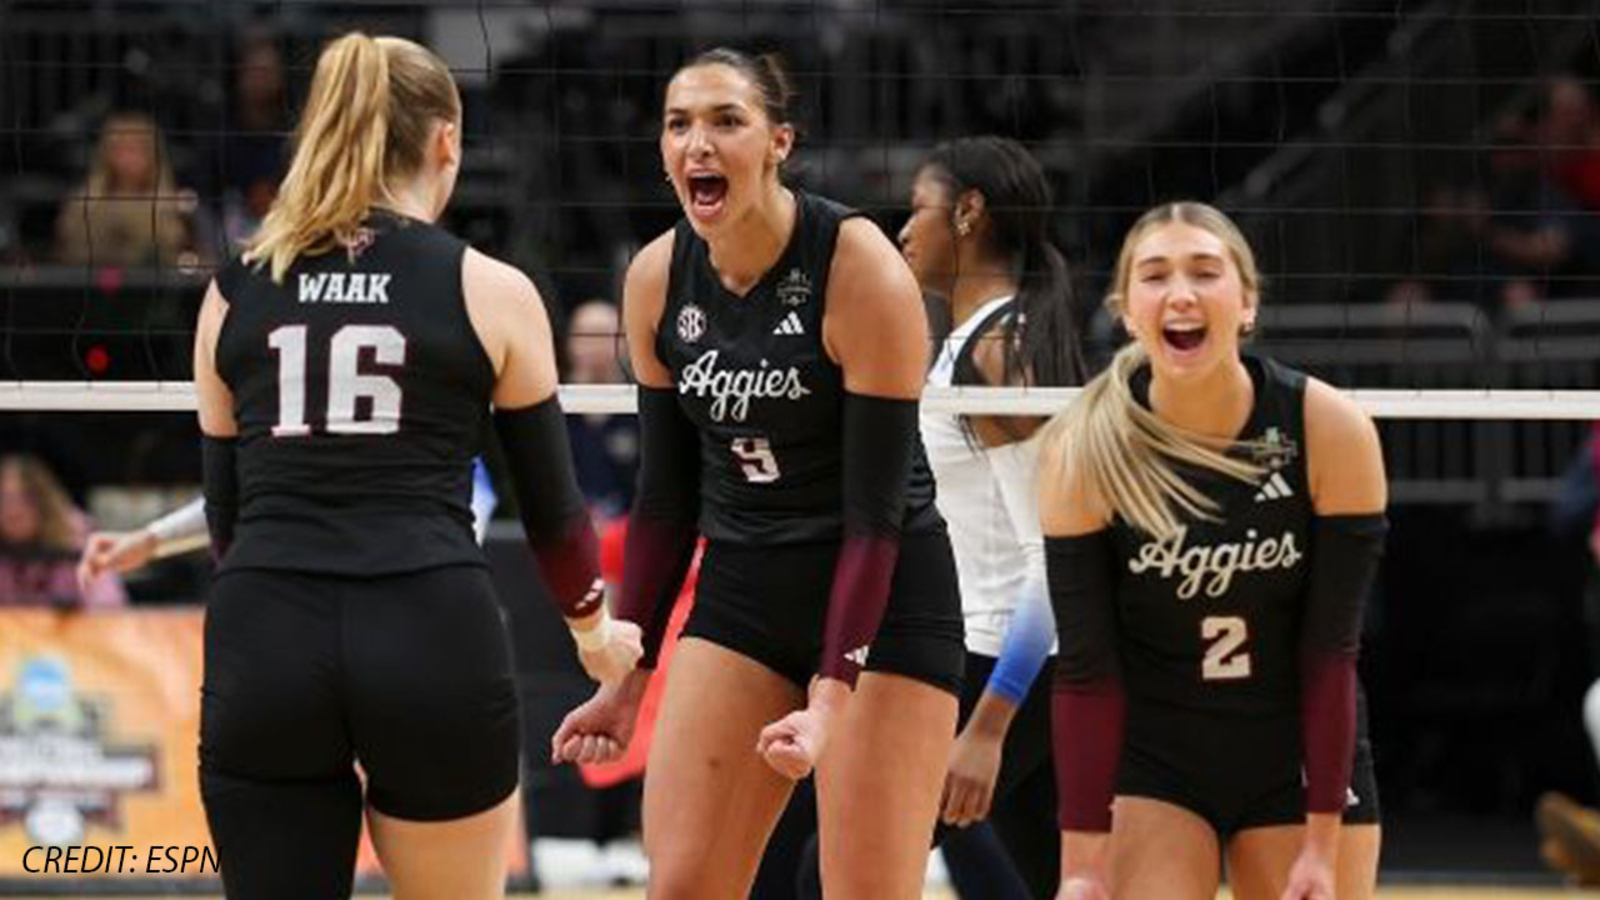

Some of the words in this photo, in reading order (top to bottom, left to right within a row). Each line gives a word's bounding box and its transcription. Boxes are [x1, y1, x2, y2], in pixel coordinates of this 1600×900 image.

[298, 272, 391, 303] WAAK
[267, 324, 406, 437] 16
[679, 350, 811, 421] Aggies
[730, 437, 782, 483] 9
[1128, 524, 1302, 600] Aggies
[1201, 616, 1251, 680] 2
